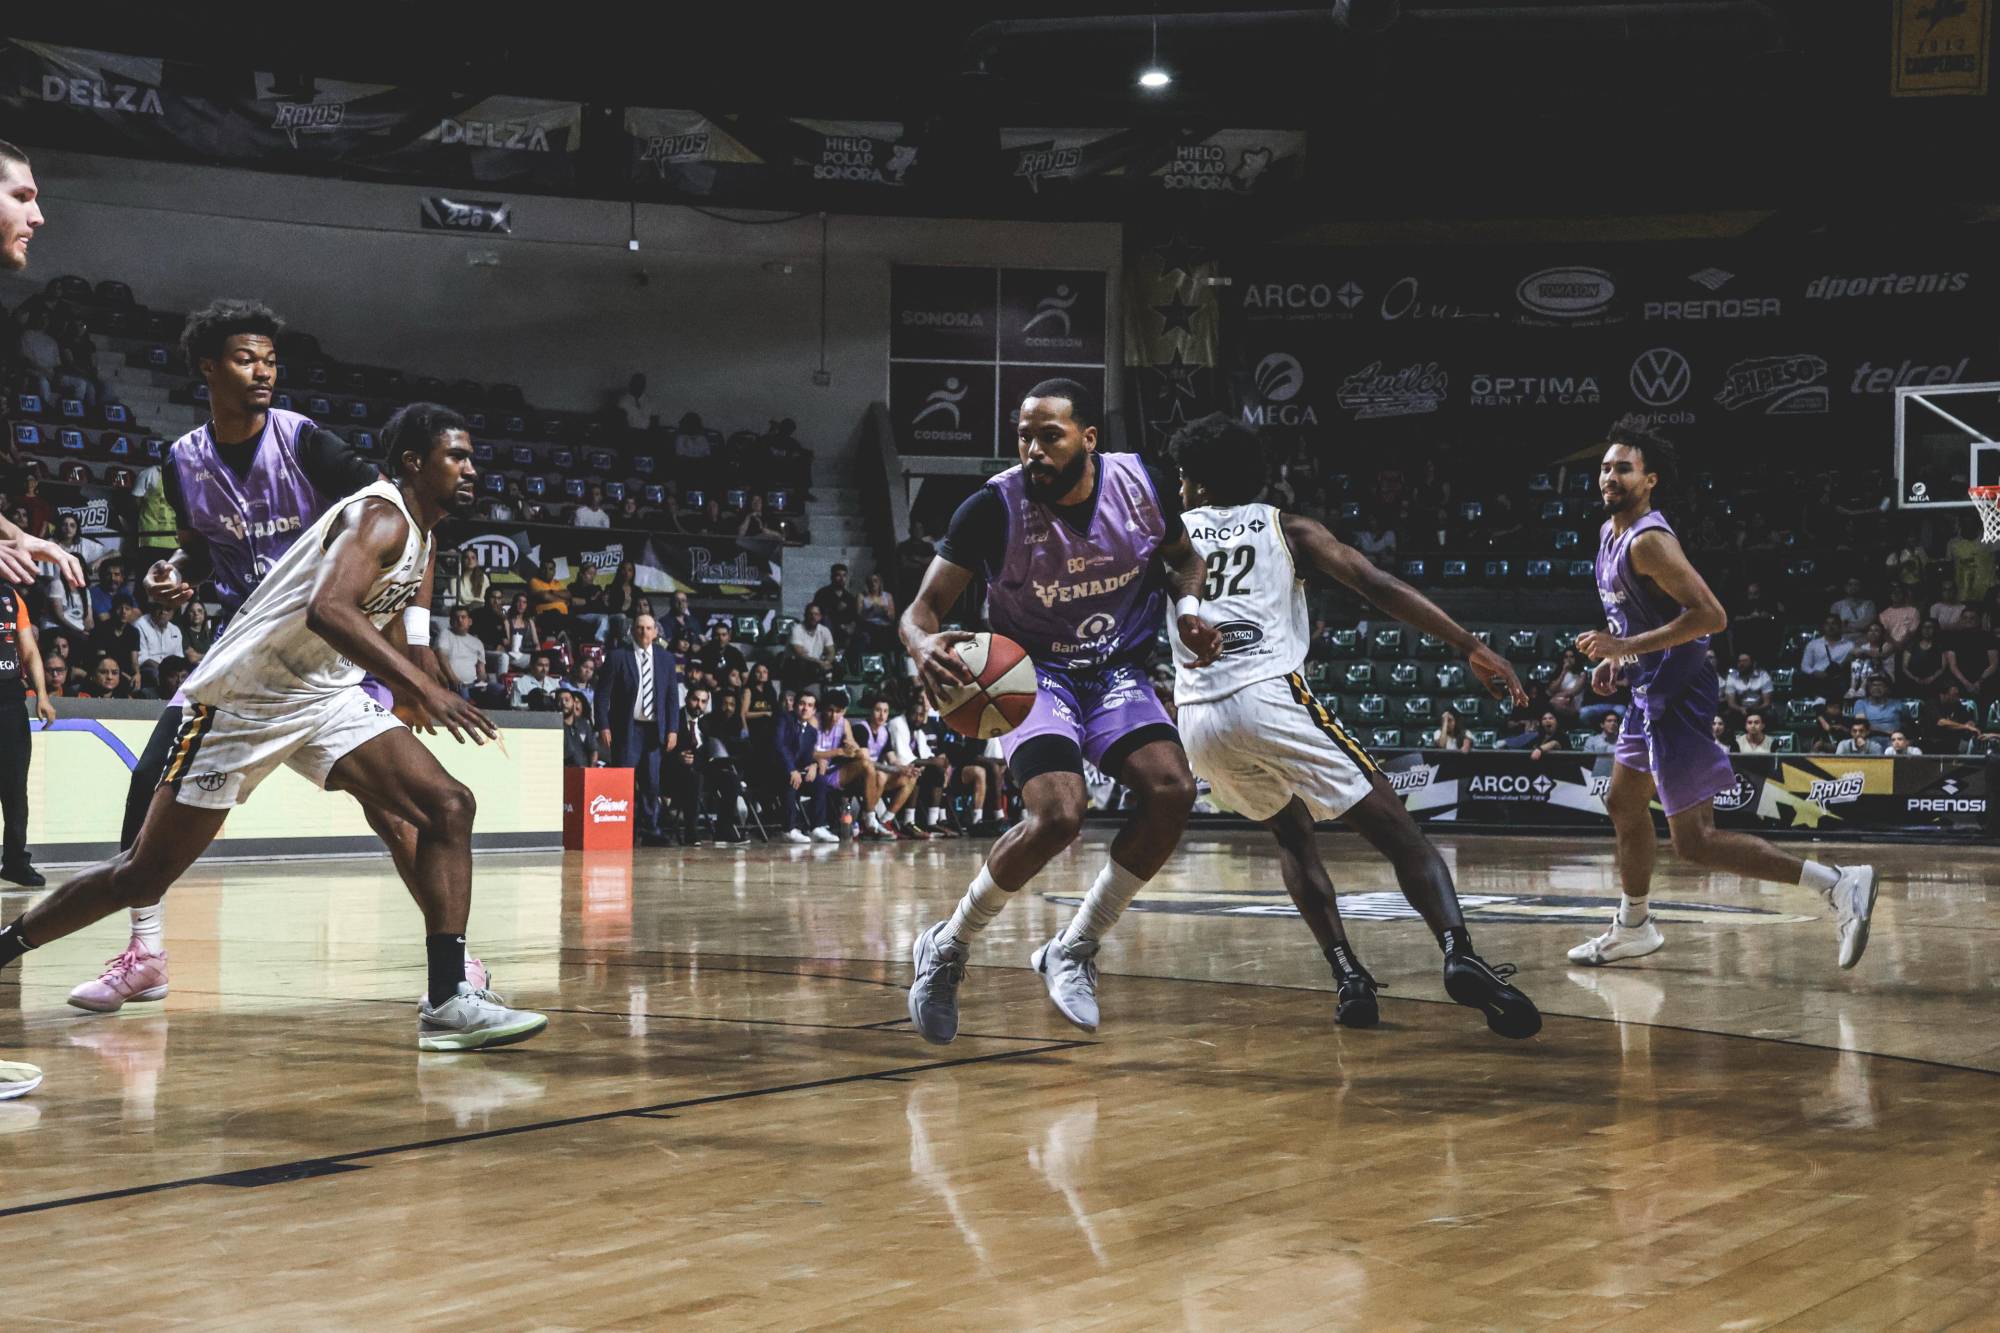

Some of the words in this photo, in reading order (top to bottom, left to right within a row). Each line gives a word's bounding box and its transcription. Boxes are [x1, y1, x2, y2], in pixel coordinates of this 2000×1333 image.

[41, 73, 164, 116] DELZA
[277, 103, 340, 127] RAYOS
[440, 118, 550, 152] DELZA
[650, 132, 708, 155] RAYOS
[825, 137, 873, 154] HIELO
[1176, 145, 1224, 161] HIELO
[823, 152, 874, 166] POLAR
[1022, 148, 1081, 172] RAYOS
[1174, 160, 1225, 174] POLAR
[813, 165, 882, 182] SONORA
[1163, 173, 1233, 191] SONORA
[1539, 284, 1600, 297] TOMASON
[1805, 272, 1969, 300] dportenis
[1243, 283, 1332, 309] ARCO
[902, 311, 983, 327] SONORA
[1025, 337, 1082, 348] CODESON
[1850, 357, 1970, 393] telcel
[1471, 395, 1523, 405] RENT
[1536, 395, 1547, 404] A
[1559, 395, 1600, 404] CAR
[1241, 405, 1318, 425] MEGA
[914, 429, 972, 441] CODESON
[1191, 524, 1245, 541] ARCO
[1204, 545, 1256, 601] 32
[1469, 775, 1530, 793] ARCO
[1810, 778, 1863, 799] RAYOS
